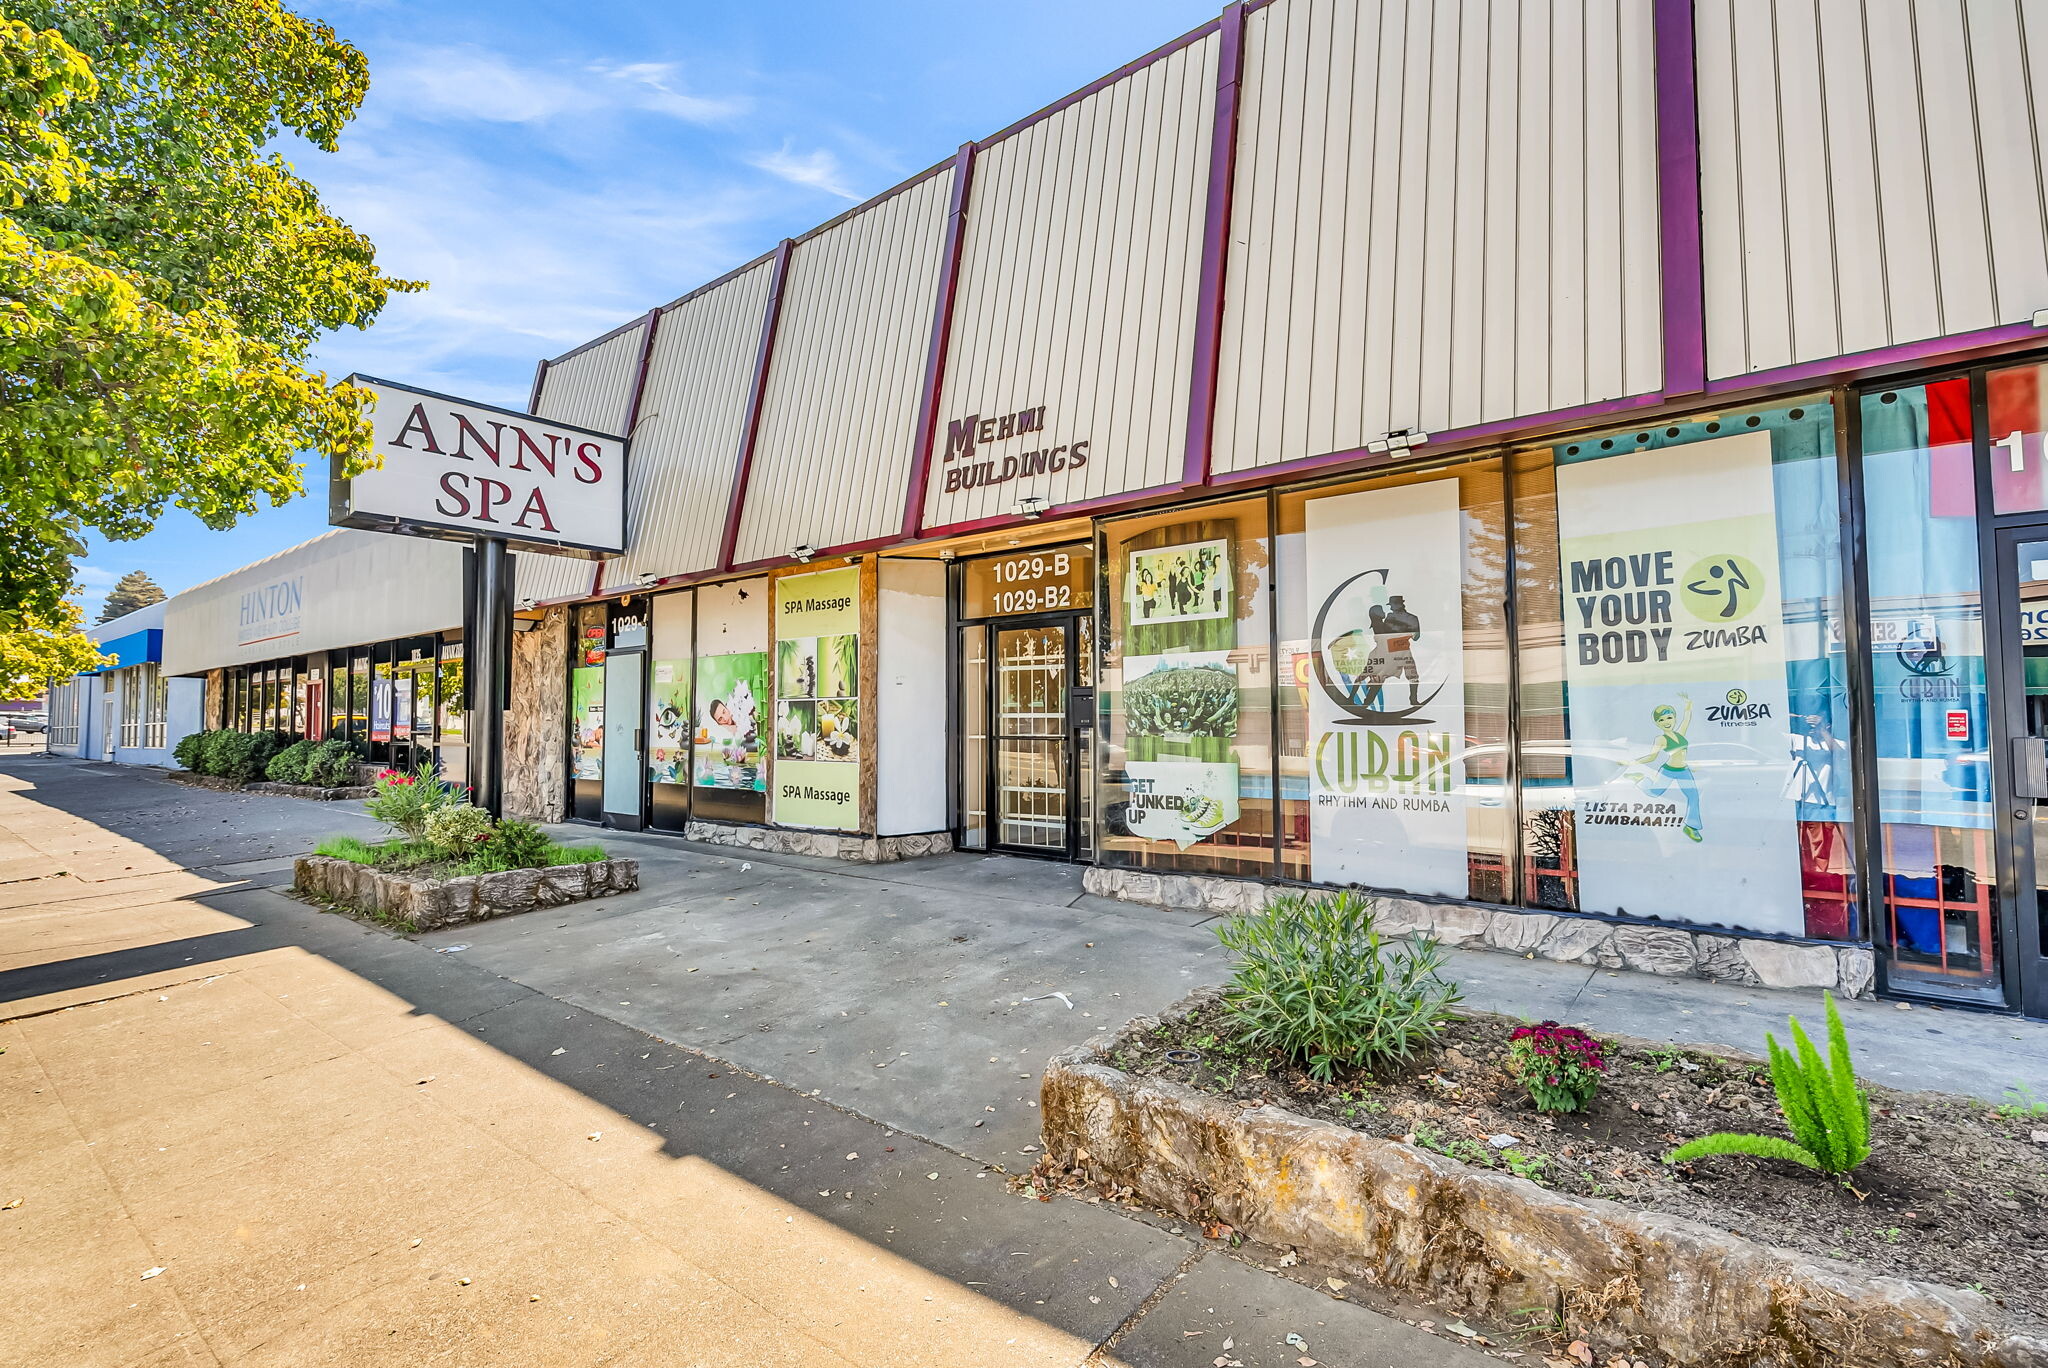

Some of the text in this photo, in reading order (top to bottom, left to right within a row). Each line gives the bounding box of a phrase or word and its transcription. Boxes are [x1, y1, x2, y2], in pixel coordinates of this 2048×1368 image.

[388, 402, 603, 485] ANN'S
[944, 406, 1046, 462] MEHMI
[1996, 430, 2048, 472] 1
[945, 440, 1089, 493] BUILDINGS
[435, 471, 560, 533] SPA
[993, 553, 1070, 583] 1029-B
[1570, 551, 1674, 593] MOVE
[239, 575, 303, 626] HINTON
[784, 596, 851, 615] SPA Massage
[993, 585, 1071, 613] 1029-B2
[1576, 590, 1672, 628] YOUR
[1578, 627, 1672, 665] BODY
[1684, 625, 1767, 650] ZUMBA
[1900, 677, 1960, 698] CUBAN
[1705, 704, 1771, 722] ZUMBA
[1315, 729, 1451, 796] CUBAN
[782, 785, 850, 804] SPA Massage
[1131, 778, 1156, 793] GET
[1128, 809, 1146, 824] UP
[1318, 795, 1450, 812] RHYTHM AND RUMBA
[1584, 802, 1676, 815] LISTA PARA
[1584, 814, 1684, 828] ZUMBAAA!!!
